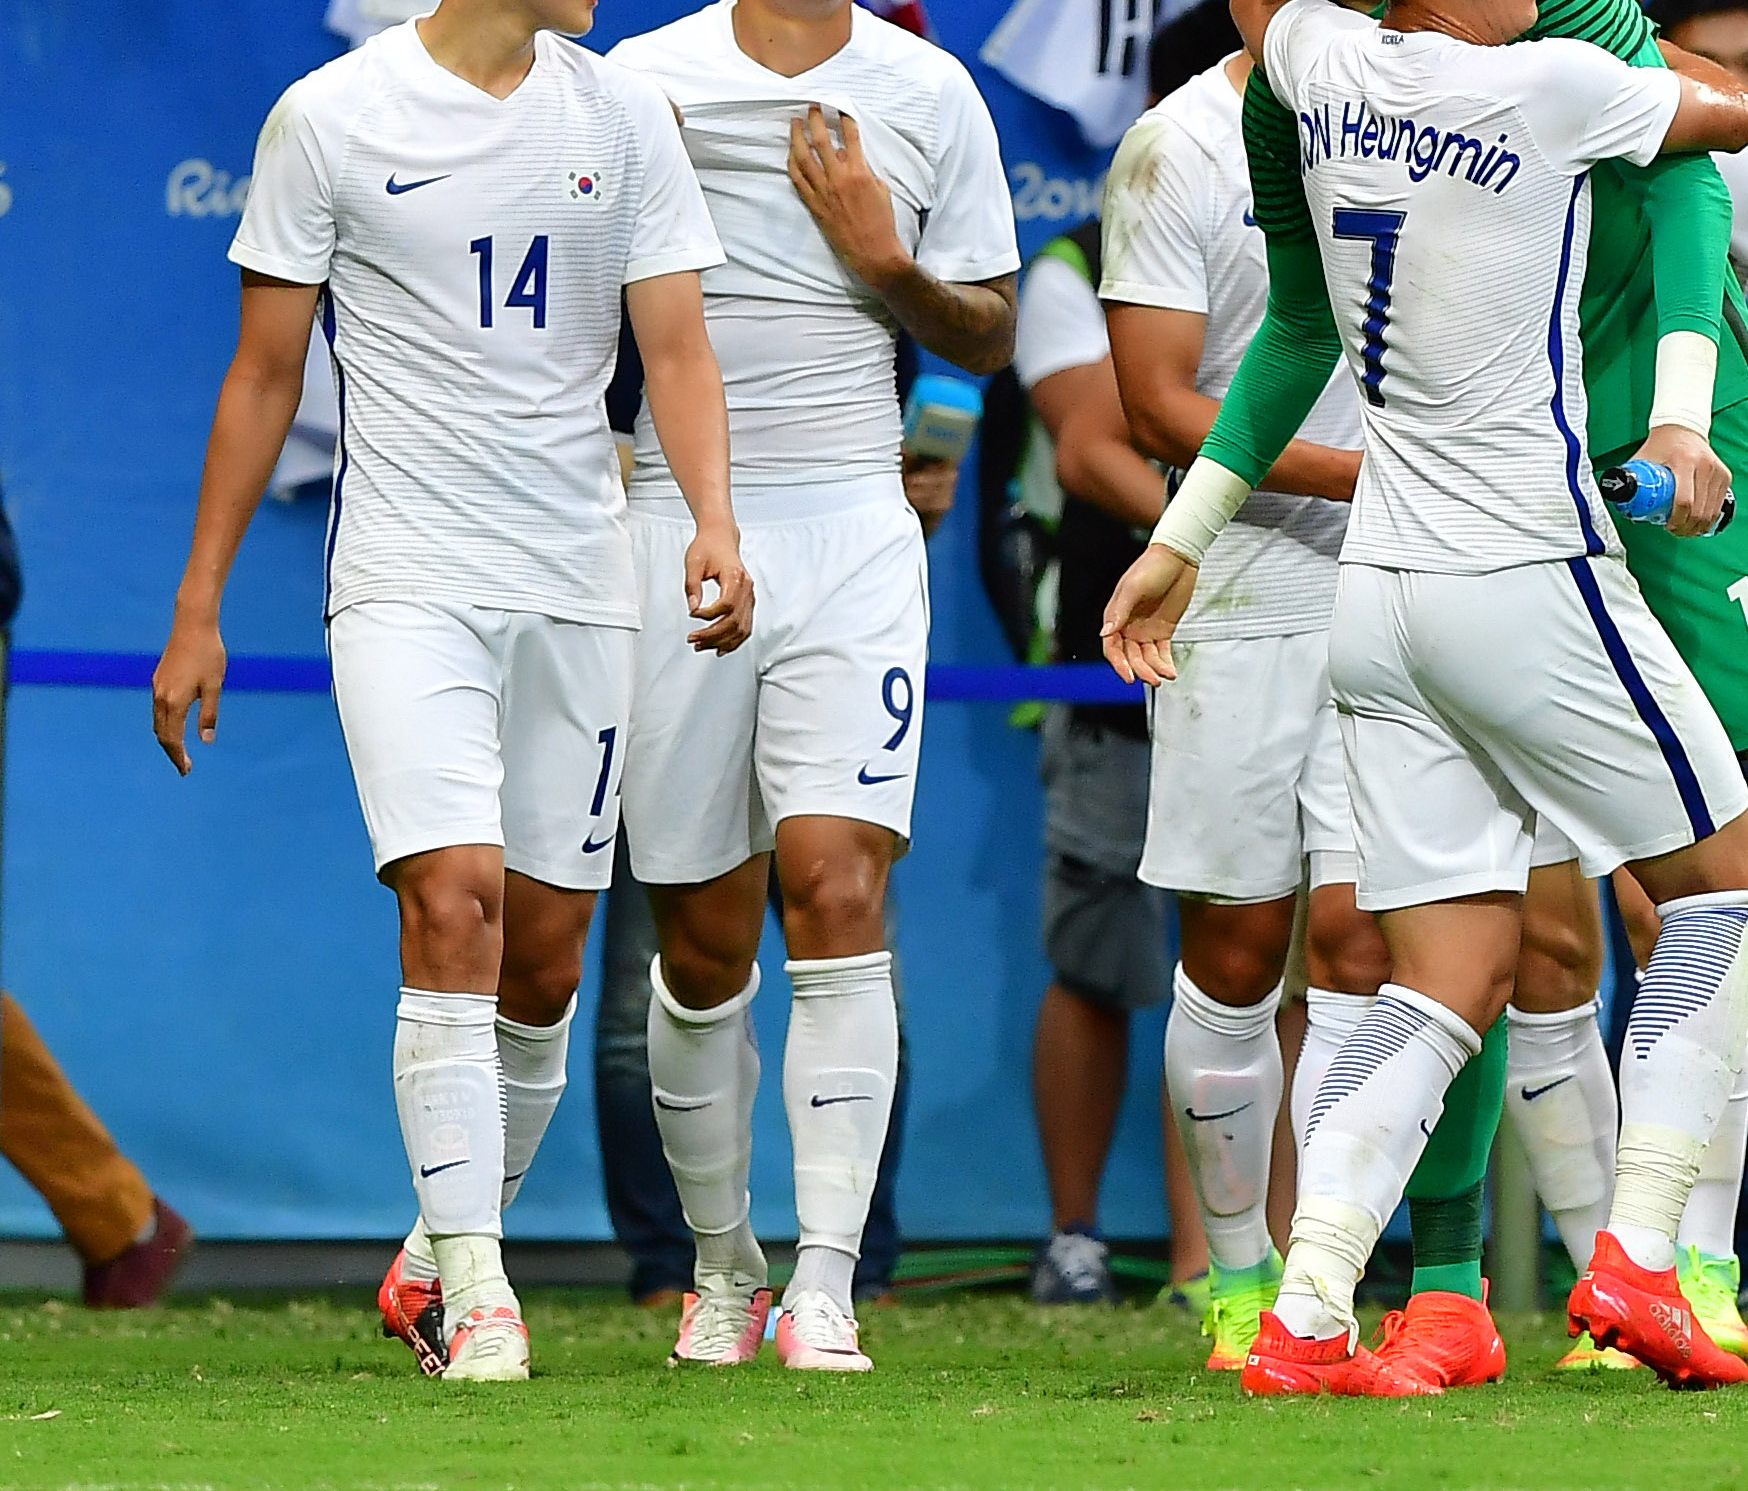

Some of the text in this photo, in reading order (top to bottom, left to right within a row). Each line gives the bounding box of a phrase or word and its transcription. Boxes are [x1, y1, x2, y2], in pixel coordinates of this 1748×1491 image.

[1381, 34, 1404, 45] KOREA
[1340, 101, 1521, 194] Heungmin
[469, 235, 549, 328] 14
[1333, 206, 1408, 408] 7
[881, 667, 913, 752] 9
[589, 725, 621, 817] 1
[1648, 1302, 1693, 1359] adidas
